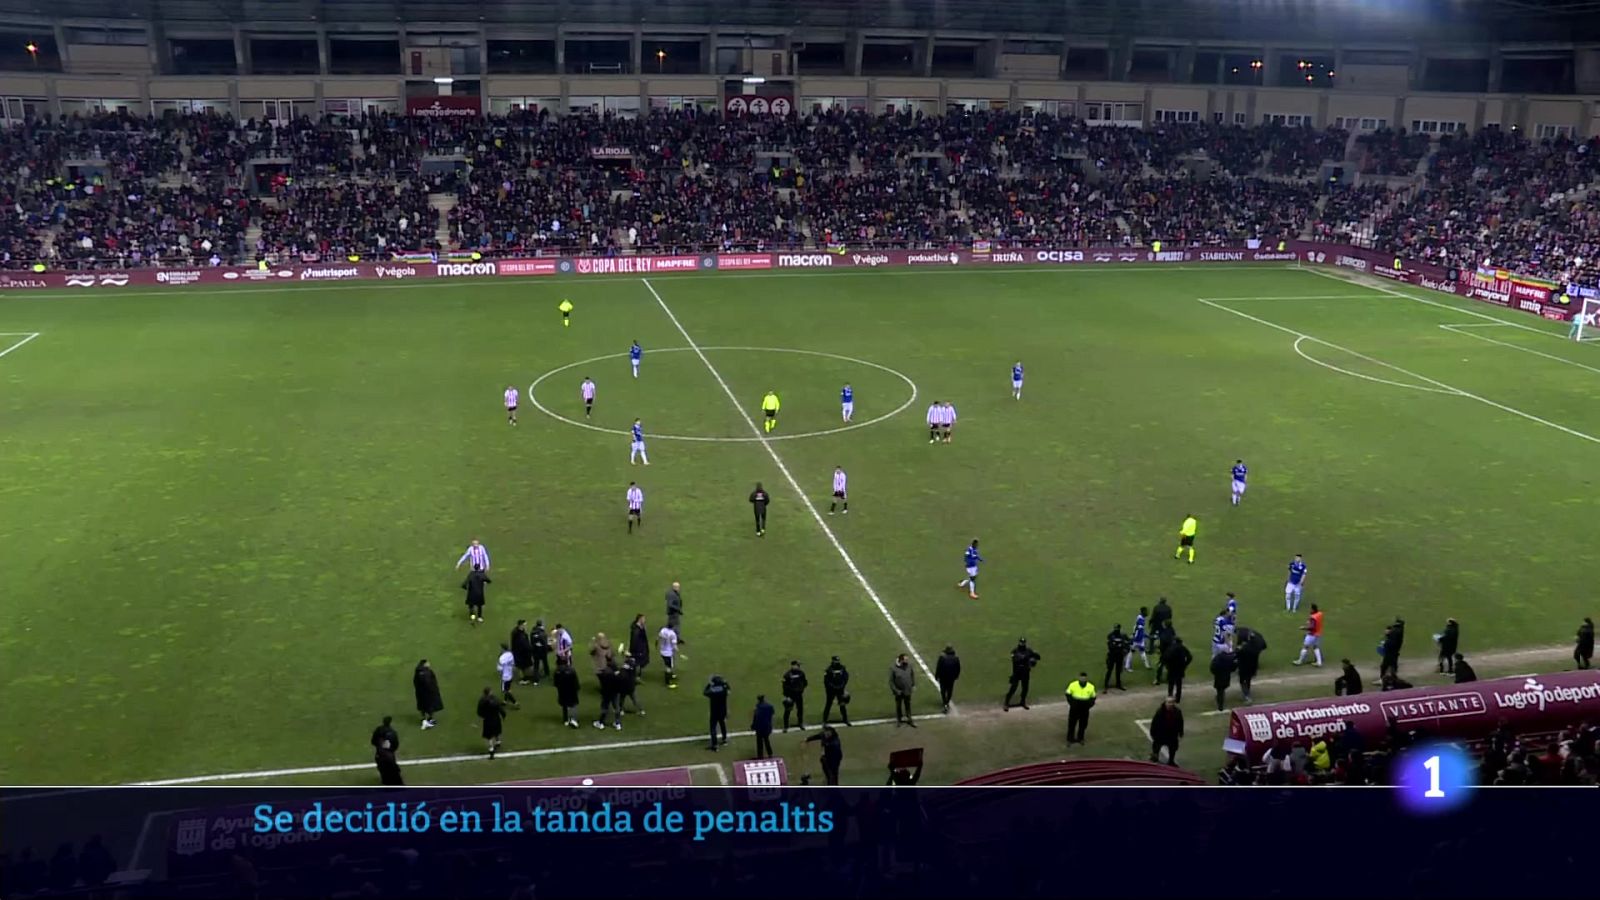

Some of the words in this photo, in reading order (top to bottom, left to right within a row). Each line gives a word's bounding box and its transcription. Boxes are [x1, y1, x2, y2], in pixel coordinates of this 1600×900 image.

[592, 147, 604, 155] LA
[605, 147, 630, 155] RIOJA
[656, 258, 696, 269] MAPFRE
[778, 254, 832, 267] macron
[992, 252, 1024, 262] IRUÑA
[437, 261, 496, 277] macron
[592, 258, 615, 273] COPA
[617, 257, 634, 273] DEL
[635, 257, 651, 272] REY
[311, 266, 359, 279] nutrisport
[385, 266, 416, 279] végola
[10, 280, 47, 288] PAULA
[1474, 288, 1510, 302] mayoral
[1515, 285, 1547, 299] MAPFRE
[1389, 696, 1481, 717] VISITANTE
[1271, 702, 1371, 725] Ayuntamiento
[1276, 724, 1295, 739] de
[1297, 718, 1348, 738] Logroñ
